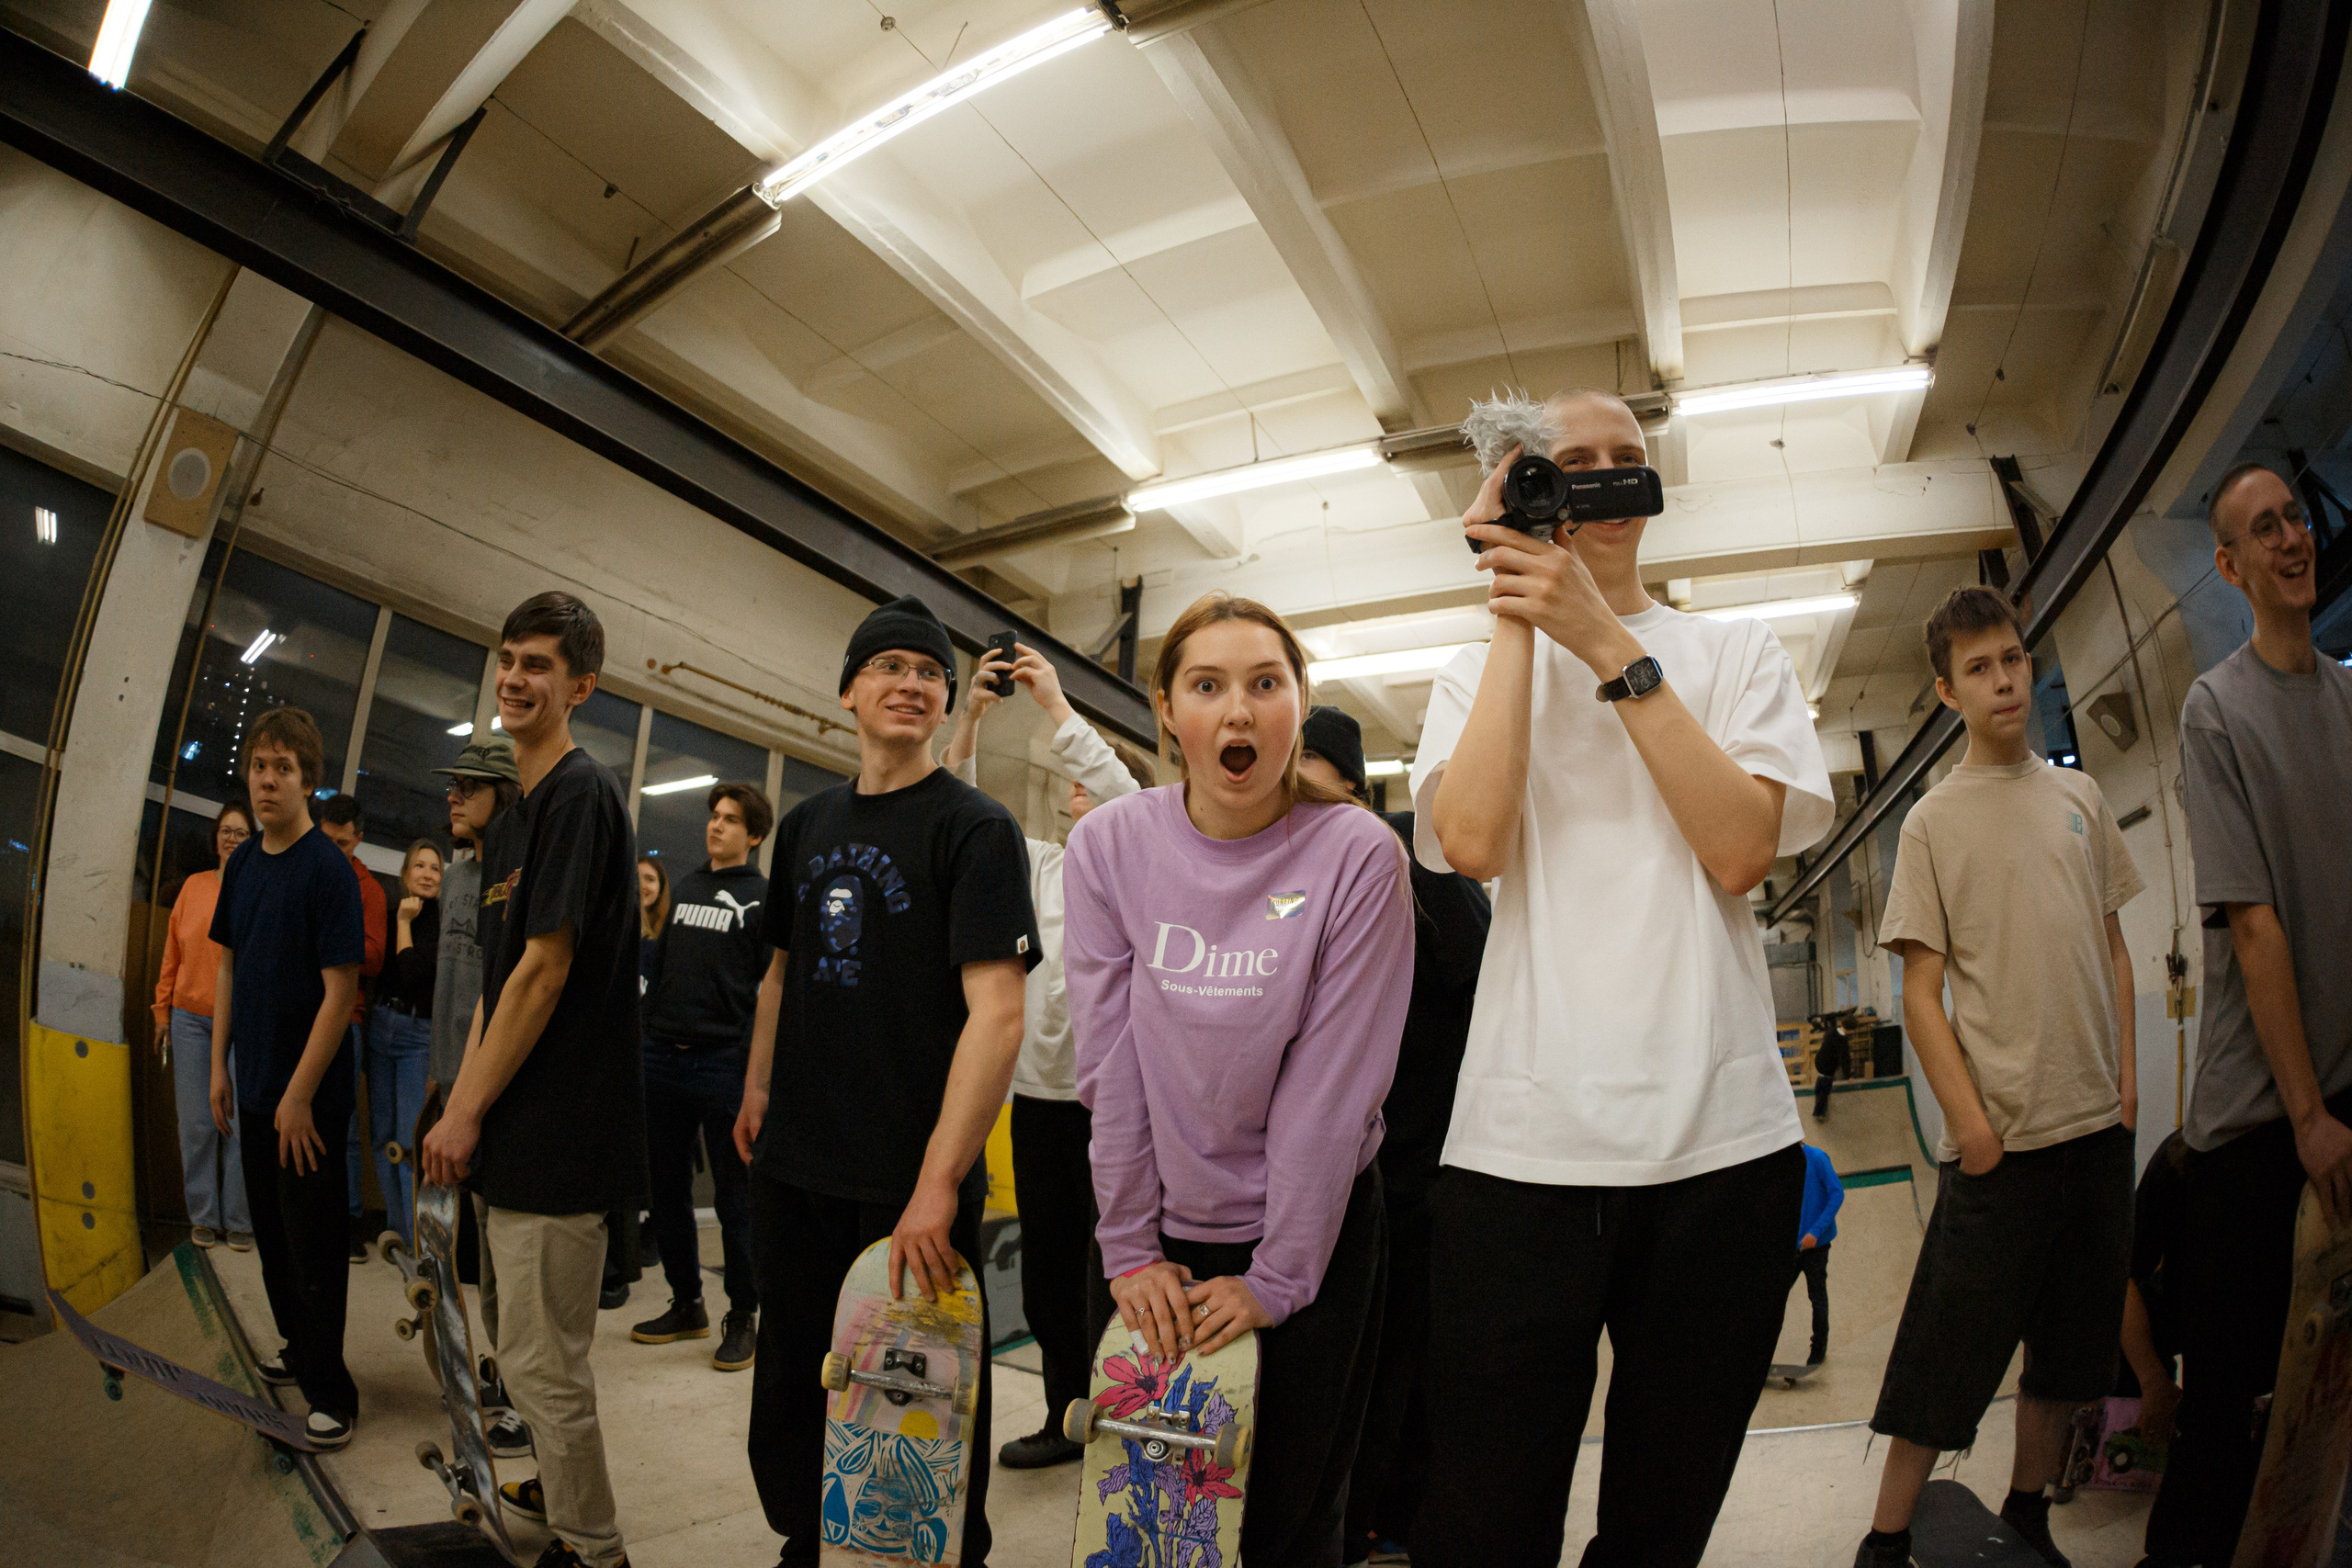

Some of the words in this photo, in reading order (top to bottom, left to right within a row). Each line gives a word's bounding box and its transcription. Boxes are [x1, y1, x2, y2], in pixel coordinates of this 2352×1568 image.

[673, 903, 734, 932] PUMA
[1146, 920, 1279, 977] Dime
[1160, 979, 1263, 996] Sous-Vêtements
